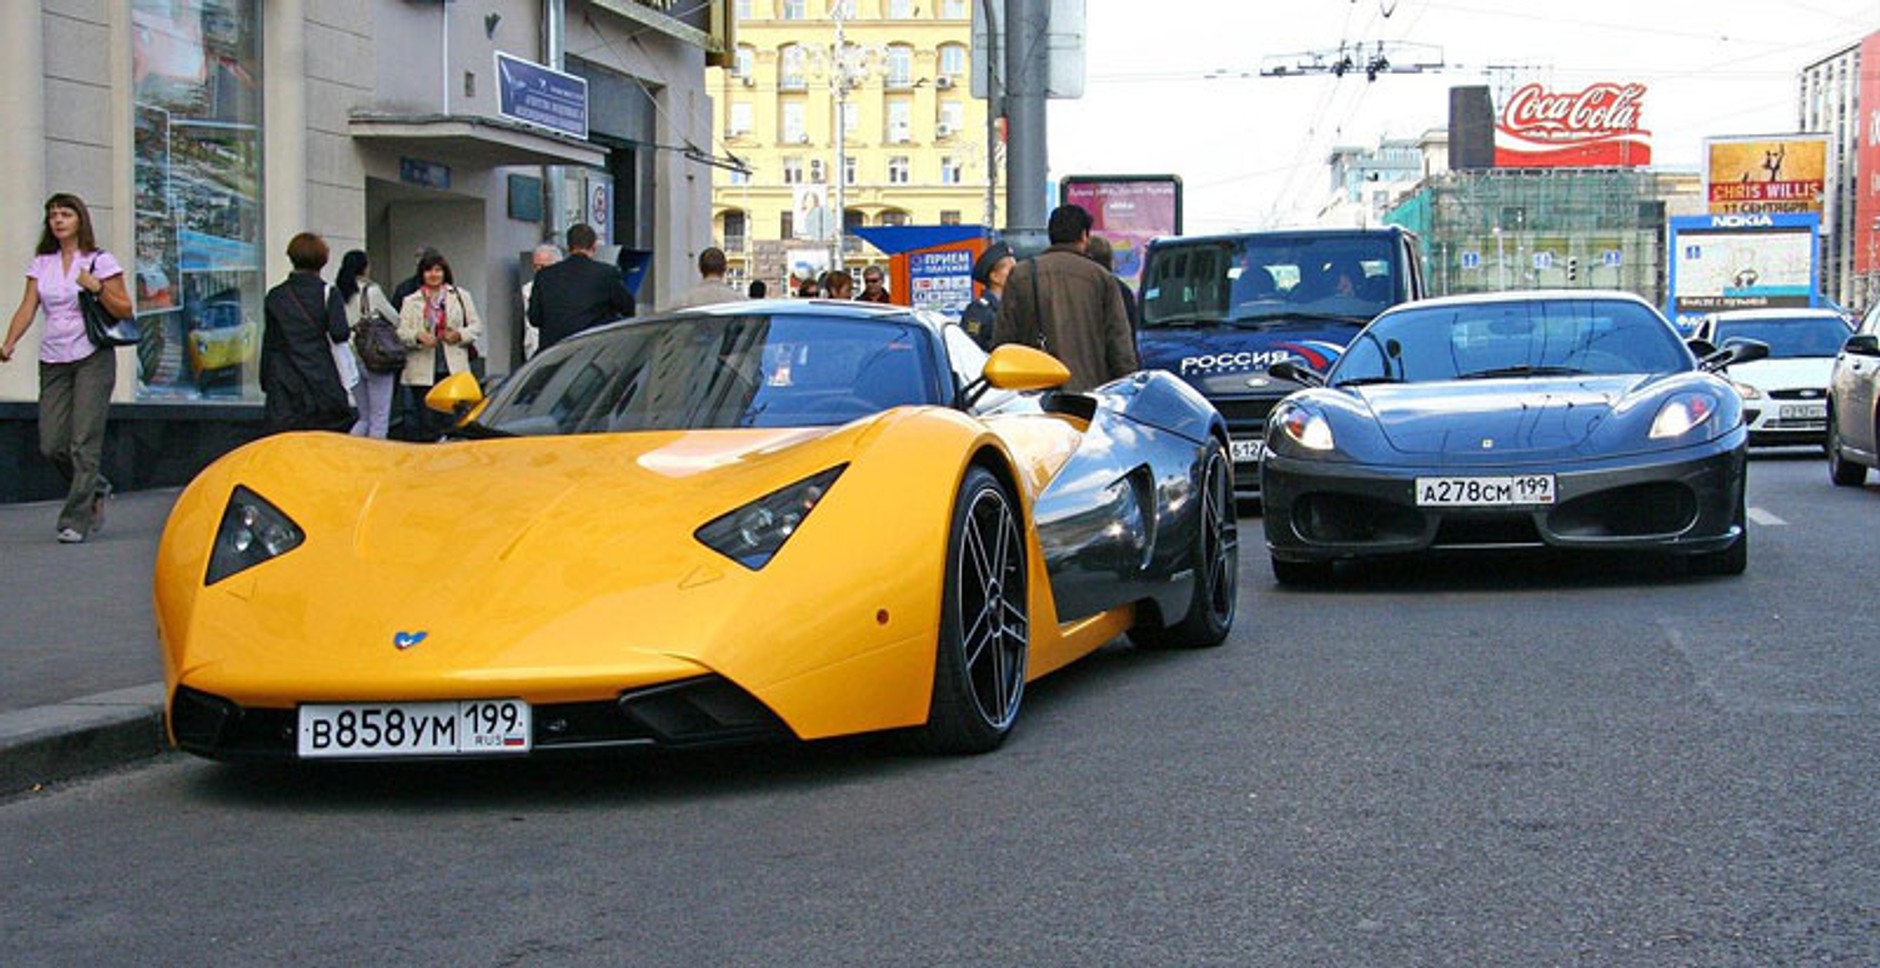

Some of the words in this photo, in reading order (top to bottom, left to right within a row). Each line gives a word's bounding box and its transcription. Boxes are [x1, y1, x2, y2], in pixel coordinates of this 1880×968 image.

[1713, 183, 1761, 199] CHRIS
[1767, 182, 1819, 198] WILLIS
[1740, 202, 1808, 213] СЕНТЯБРЯ
[1712, 216, 1773, 226] NOKIA
[925, 252, 970, 264] ПРИЕМ
[1182, 350, 1289, 372] РОССИЯ
[1230, 442, 1260, 457] 612
[1516, 477, 1549, 494] 199
[465, 703, 518, 733] 199
[475, 735, 501, 745] RUS
